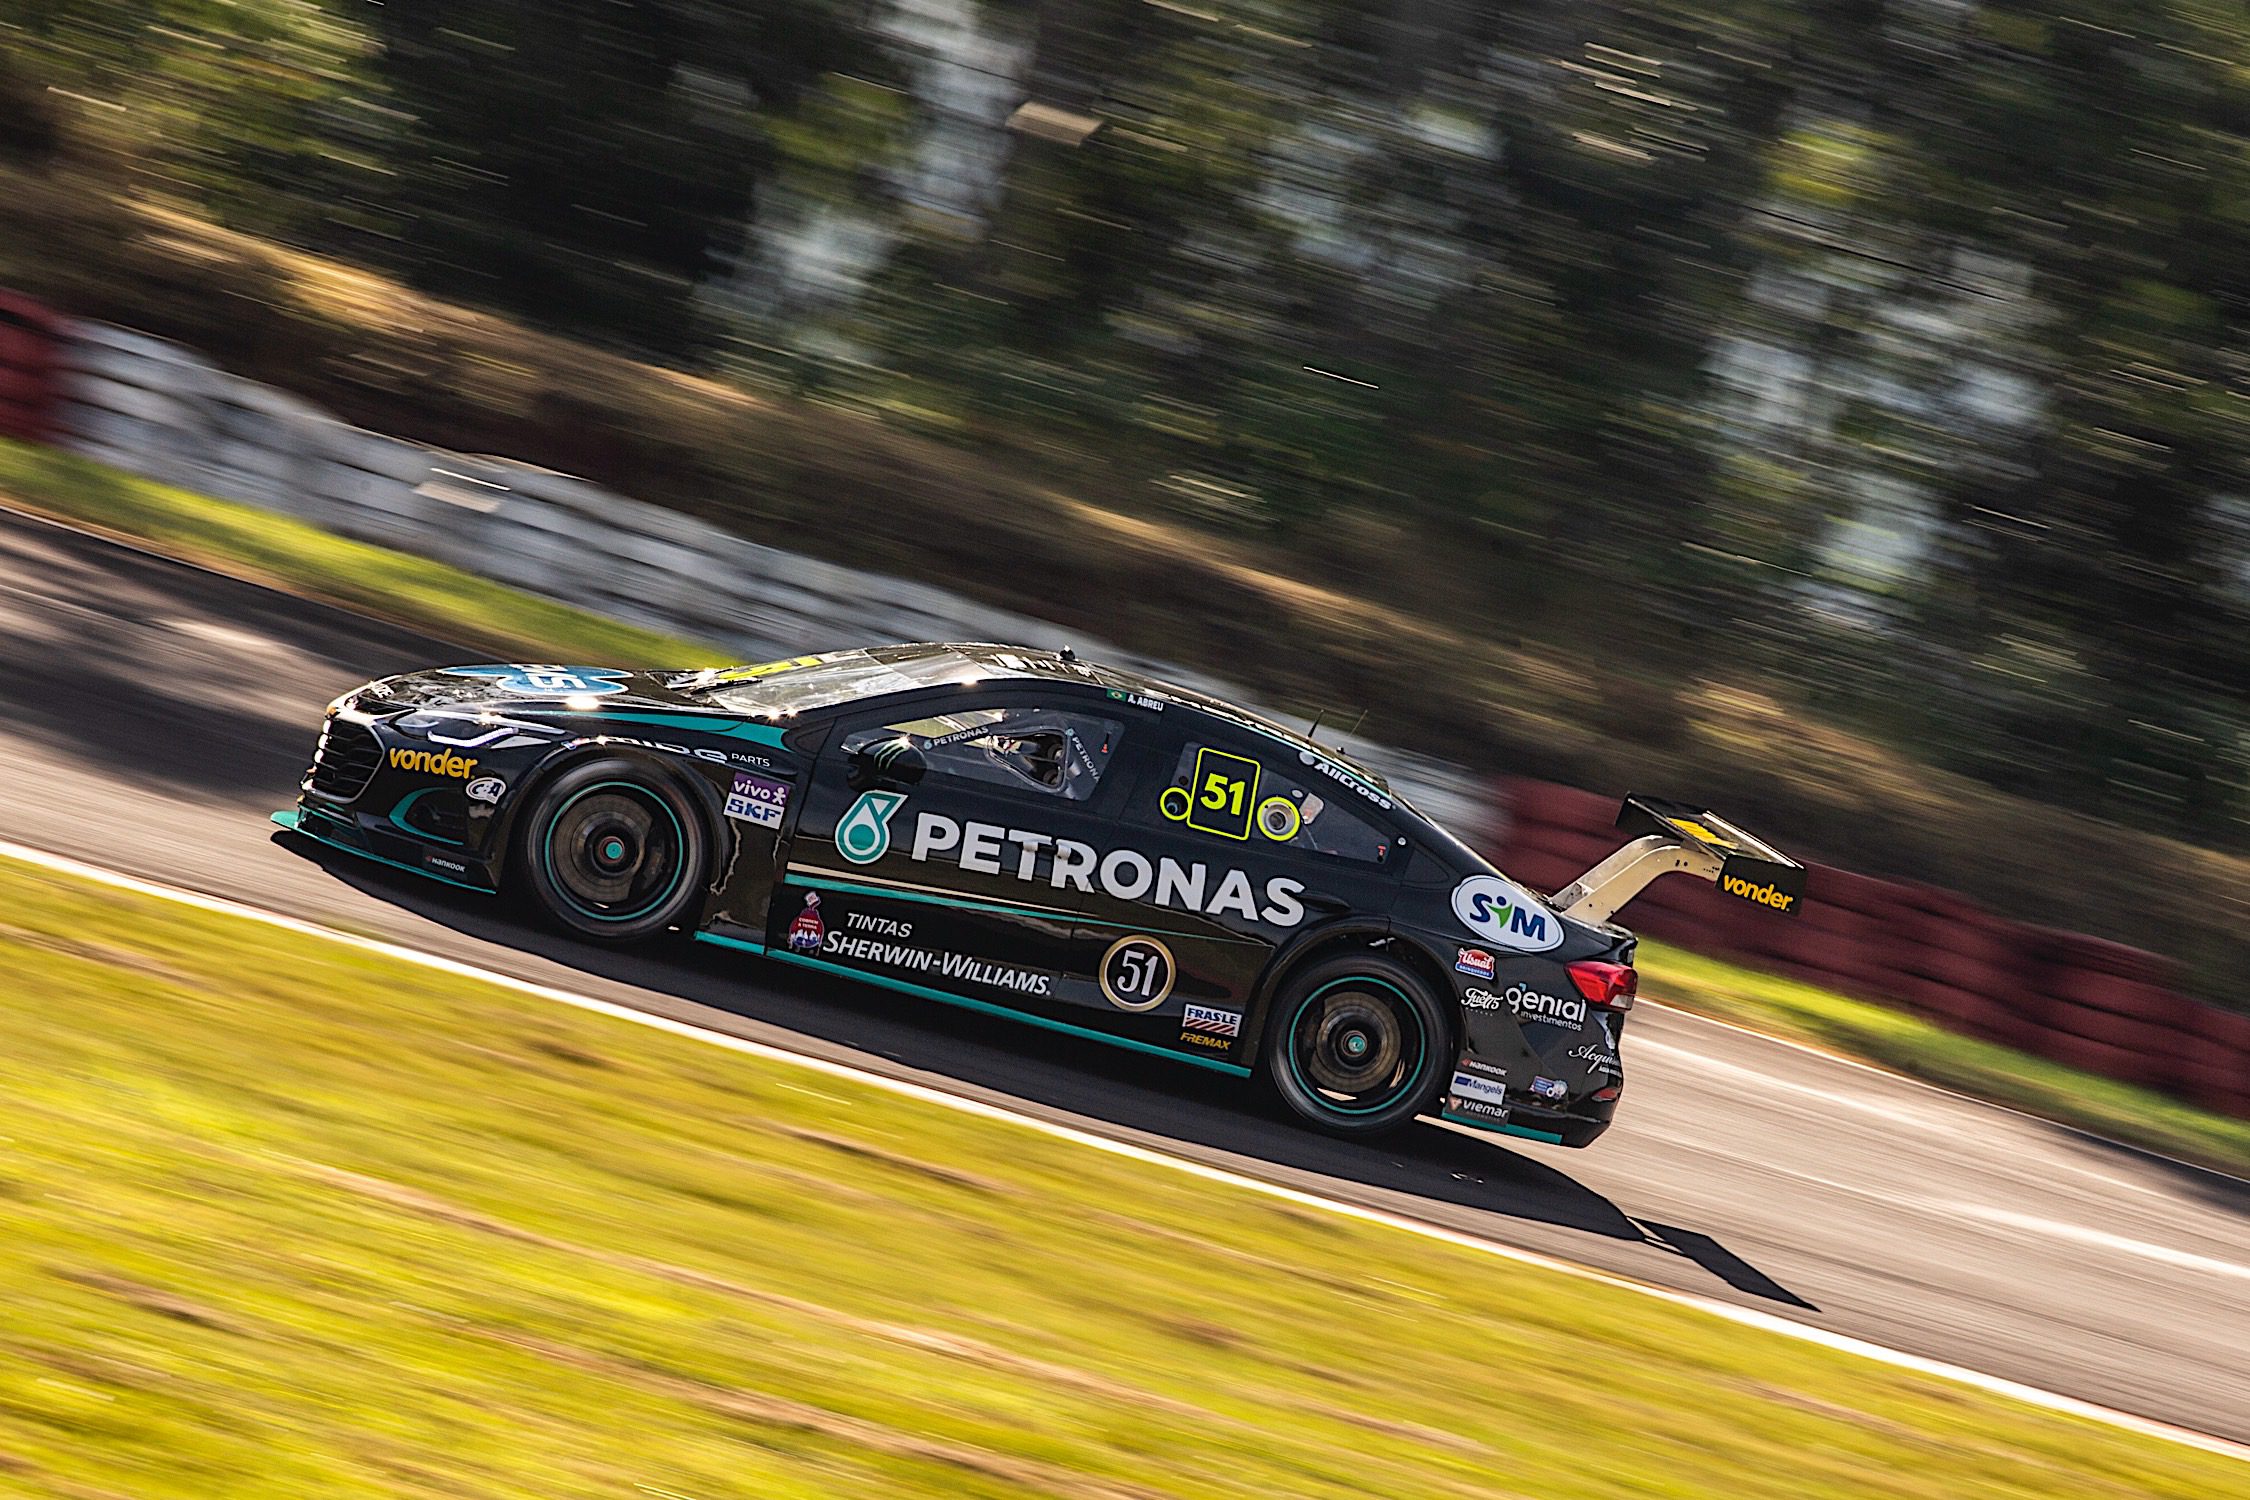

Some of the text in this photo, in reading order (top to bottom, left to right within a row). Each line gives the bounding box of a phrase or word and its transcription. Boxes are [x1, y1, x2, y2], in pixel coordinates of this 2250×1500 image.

[1137, 696, 1164, 711] ABREU
[933, 726, 989, 747] PETRONAS
[732, 753, 770, 767] PARTS
[1072, 736, 1100, 783] PETRONA
[734, 780, 770, 799] vivo
[1200, 772, 1246, 816] 51
[727, 800, 781, 821] SKF
[911, 812, 1305, 927] PETRONAS
[847, 912, 913, 938] TINTAS
[1117, 949, 1158, 997] 51
[1506, 983, 1587, 1023] genial
[1520, 1010, 1582, 1032] investimentos
[1180, 1031, 1231, 1050] FREMAX
[1468, 1079, 1502, 1095] Mangels
